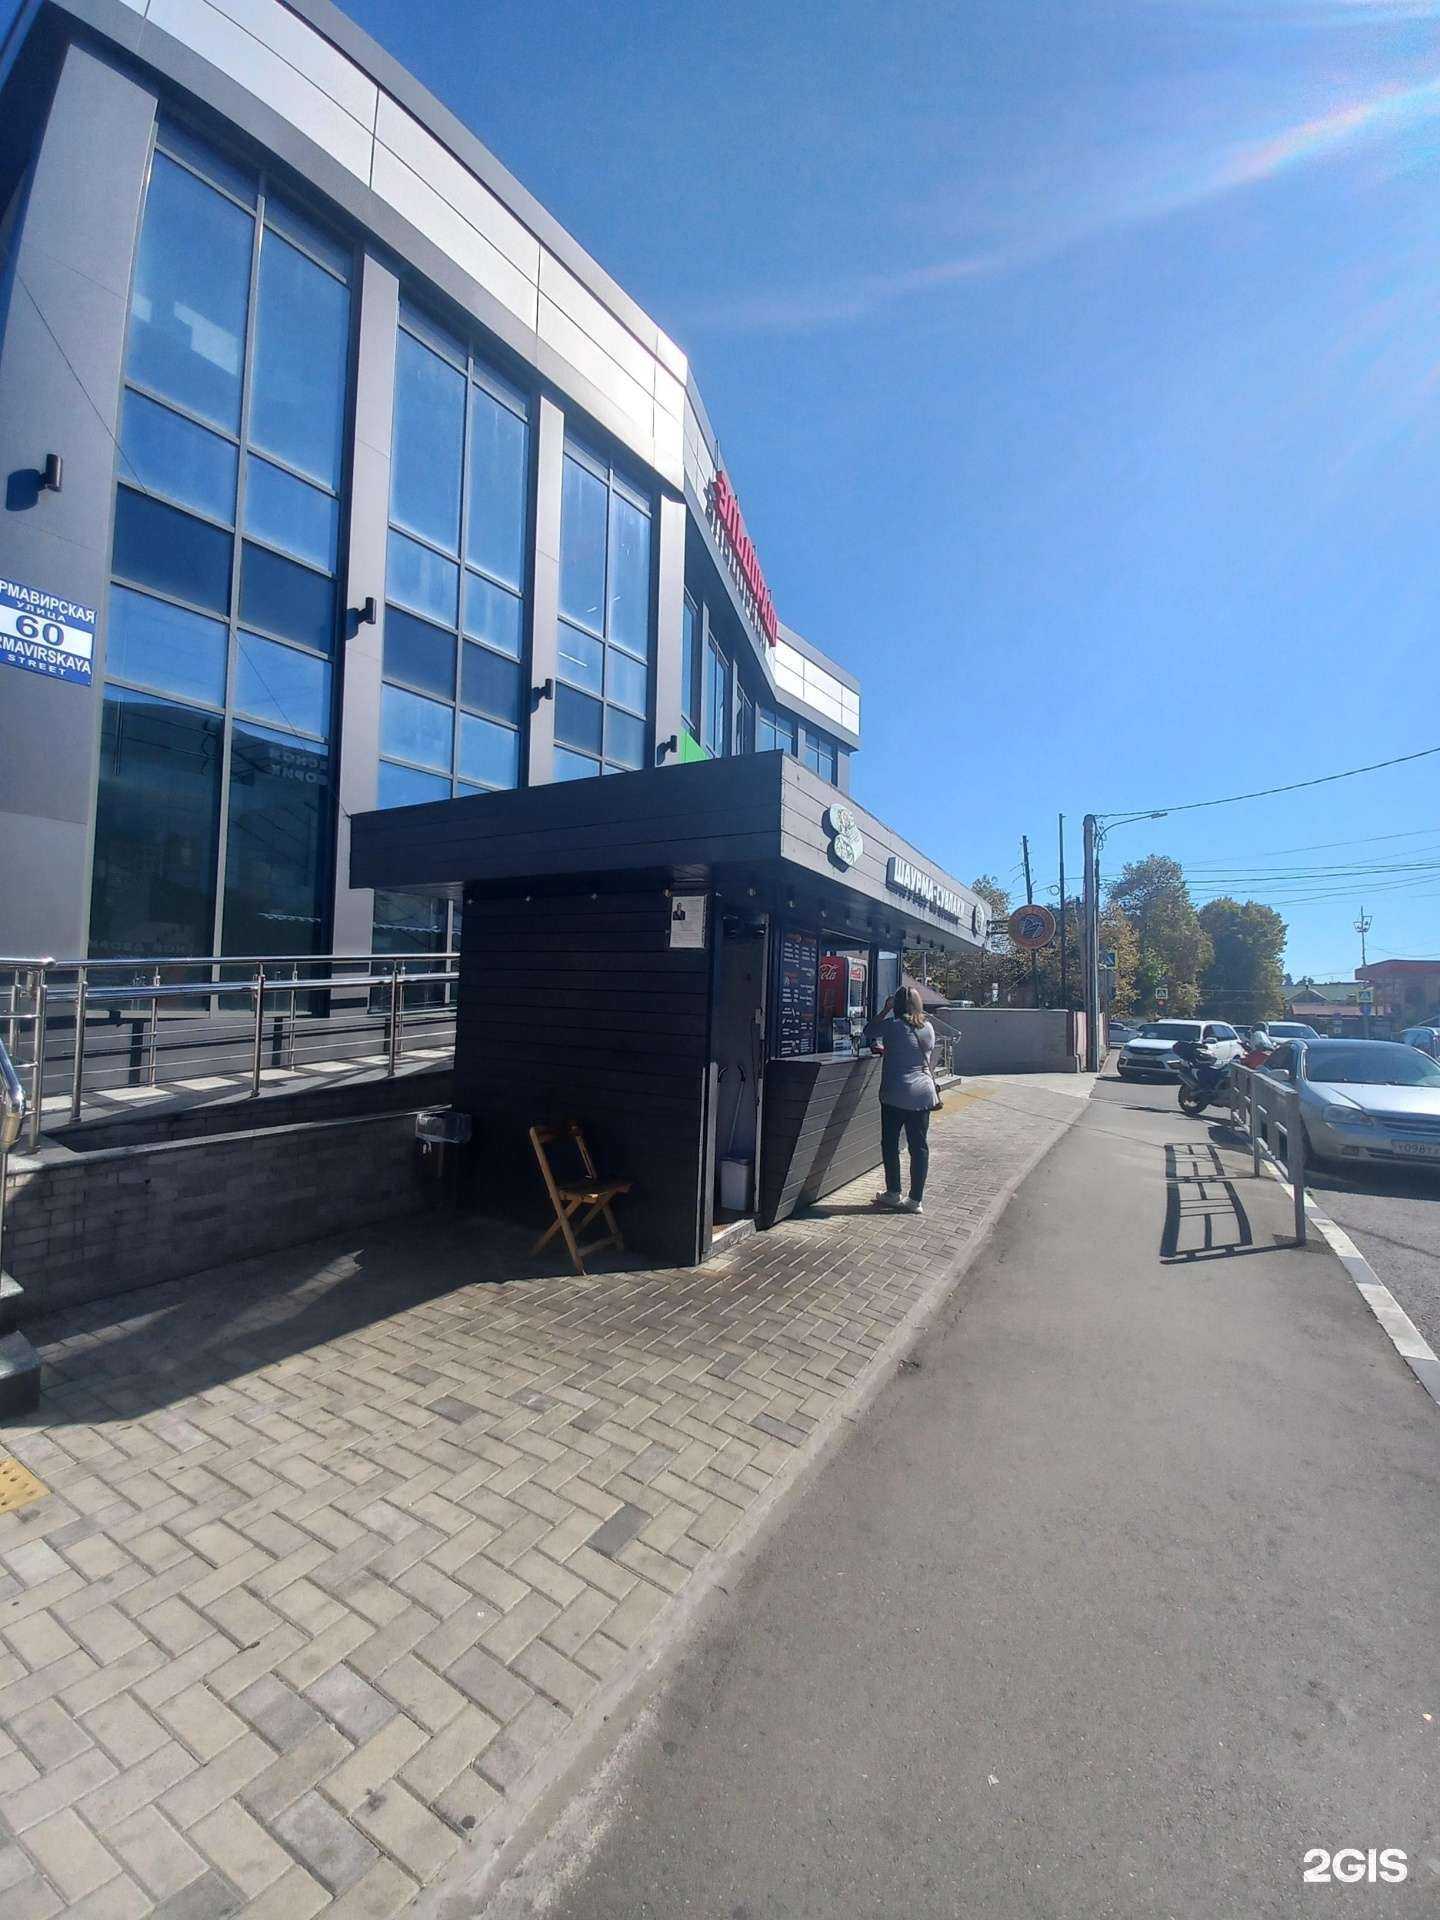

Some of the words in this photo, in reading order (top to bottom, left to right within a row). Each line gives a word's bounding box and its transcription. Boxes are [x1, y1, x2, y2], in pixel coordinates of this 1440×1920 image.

[16, 615, 64, 646] 60
[0, 636, 92, 675] MAVIRSKAYA
[8, 654, 66, 676] STREET
